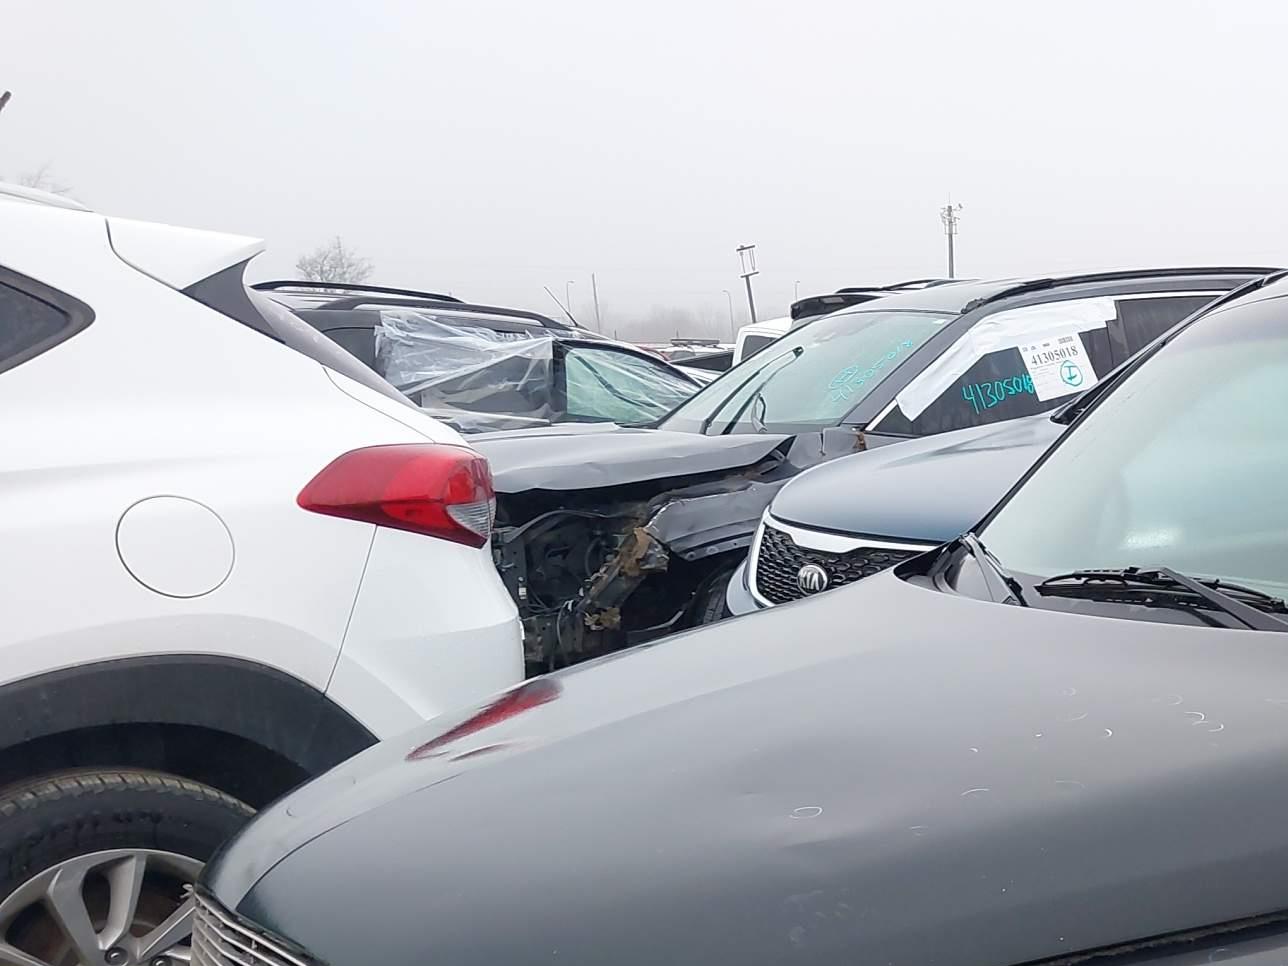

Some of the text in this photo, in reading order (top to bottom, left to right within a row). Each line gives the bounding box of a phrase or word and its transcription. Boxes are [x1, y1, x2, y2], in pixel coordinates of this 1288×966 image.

[1031, 345, 1079, 366] 41305018
[961, 373, 1036, 415] 41305018
[799, 569, 821, 592] KIA
